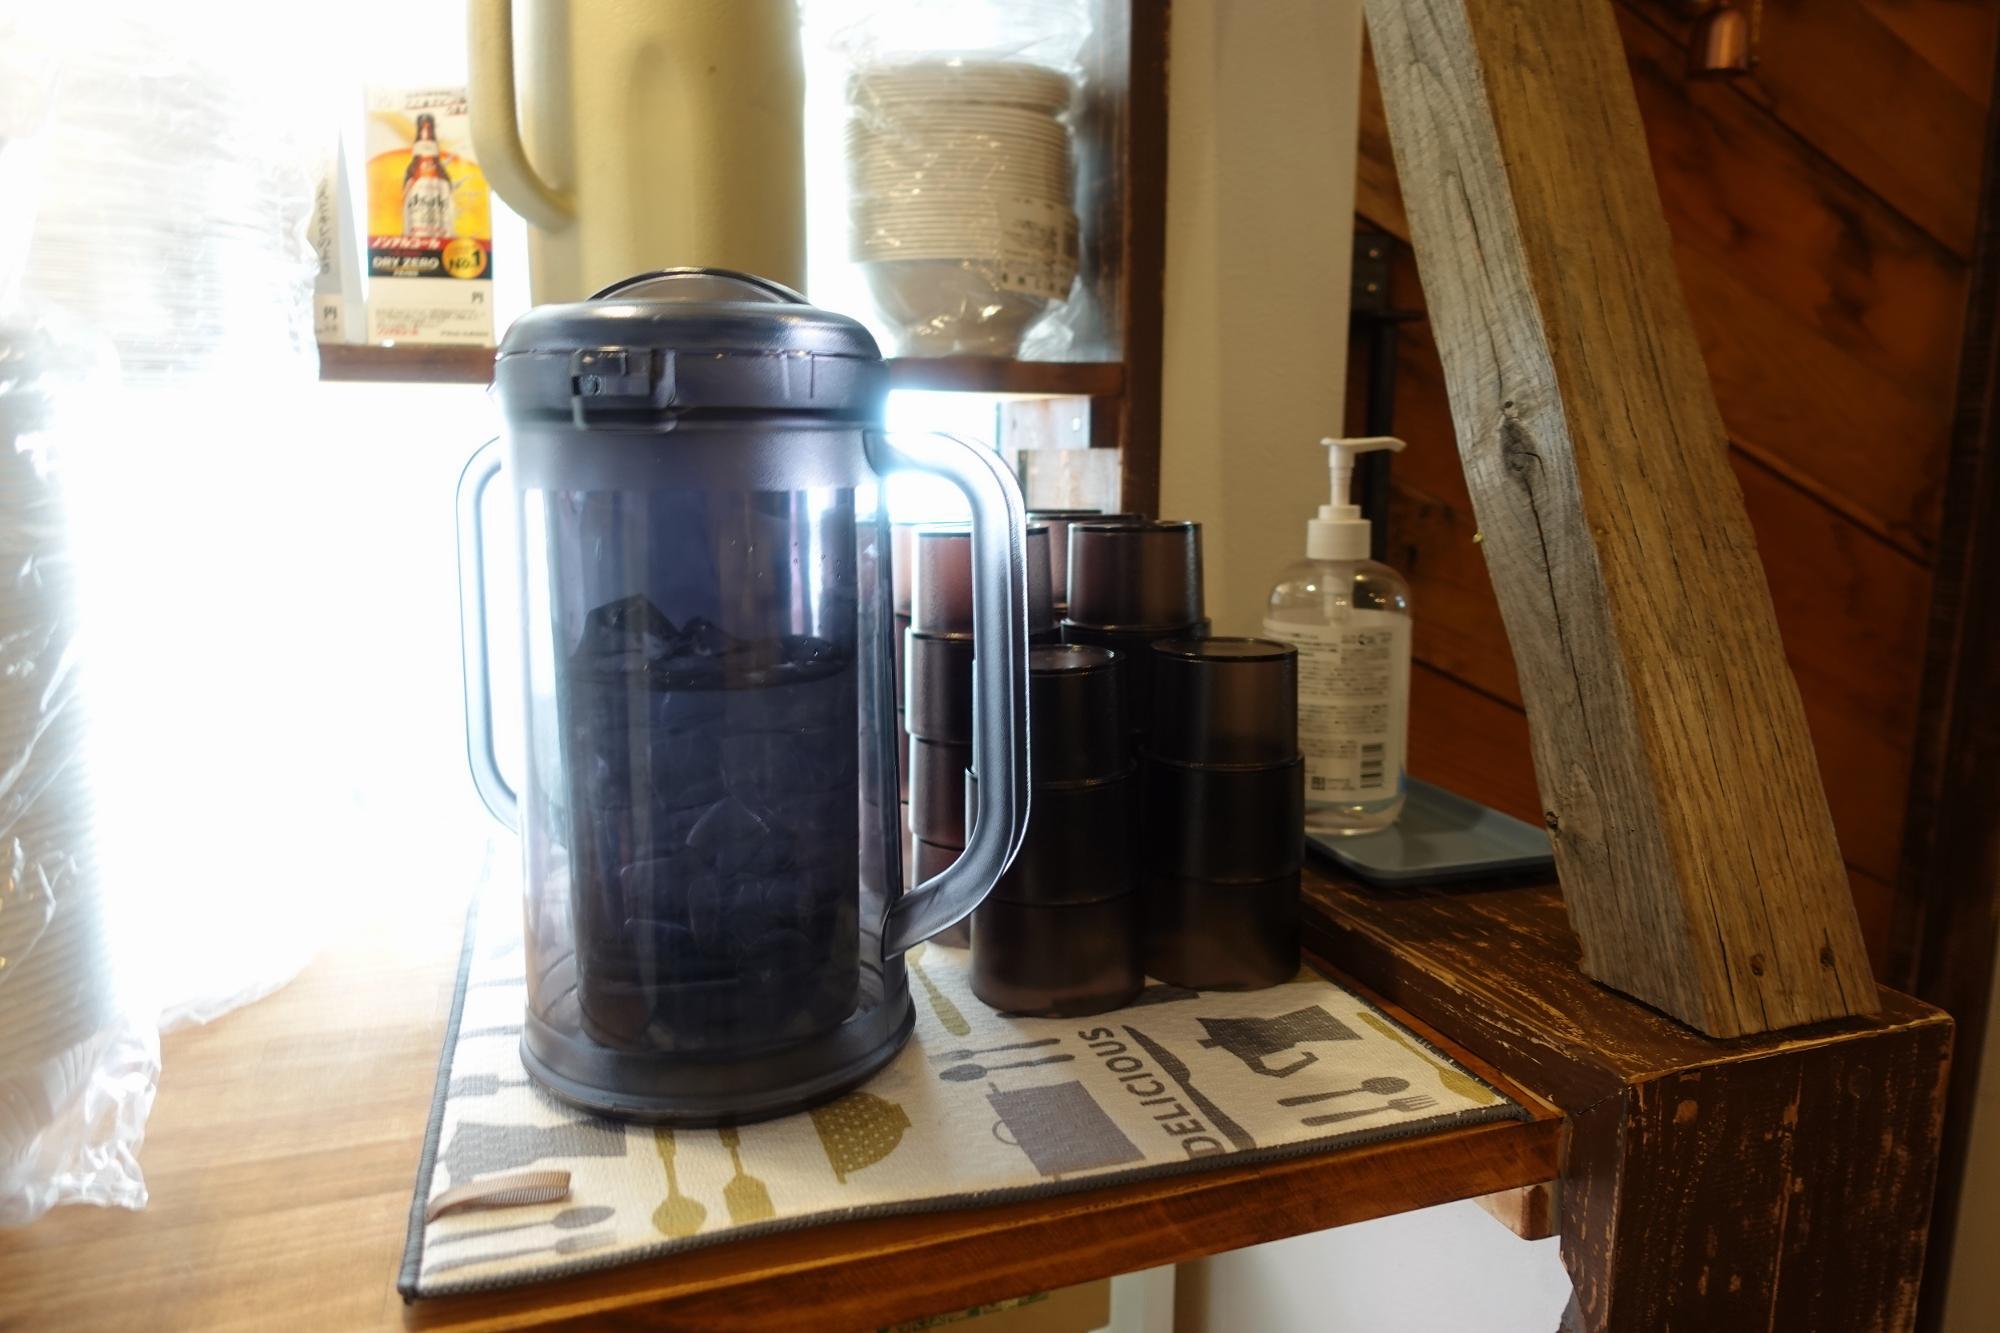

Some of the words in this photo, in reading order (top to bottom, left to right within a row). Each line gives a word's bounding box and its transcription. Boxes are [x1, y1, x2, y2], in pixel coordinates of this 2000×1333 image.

[372, 256, 400, 270] DRY
[402, 256, 440, 270] ZERO
[1078, 1027, 1226, 1159] DELICIOUS
